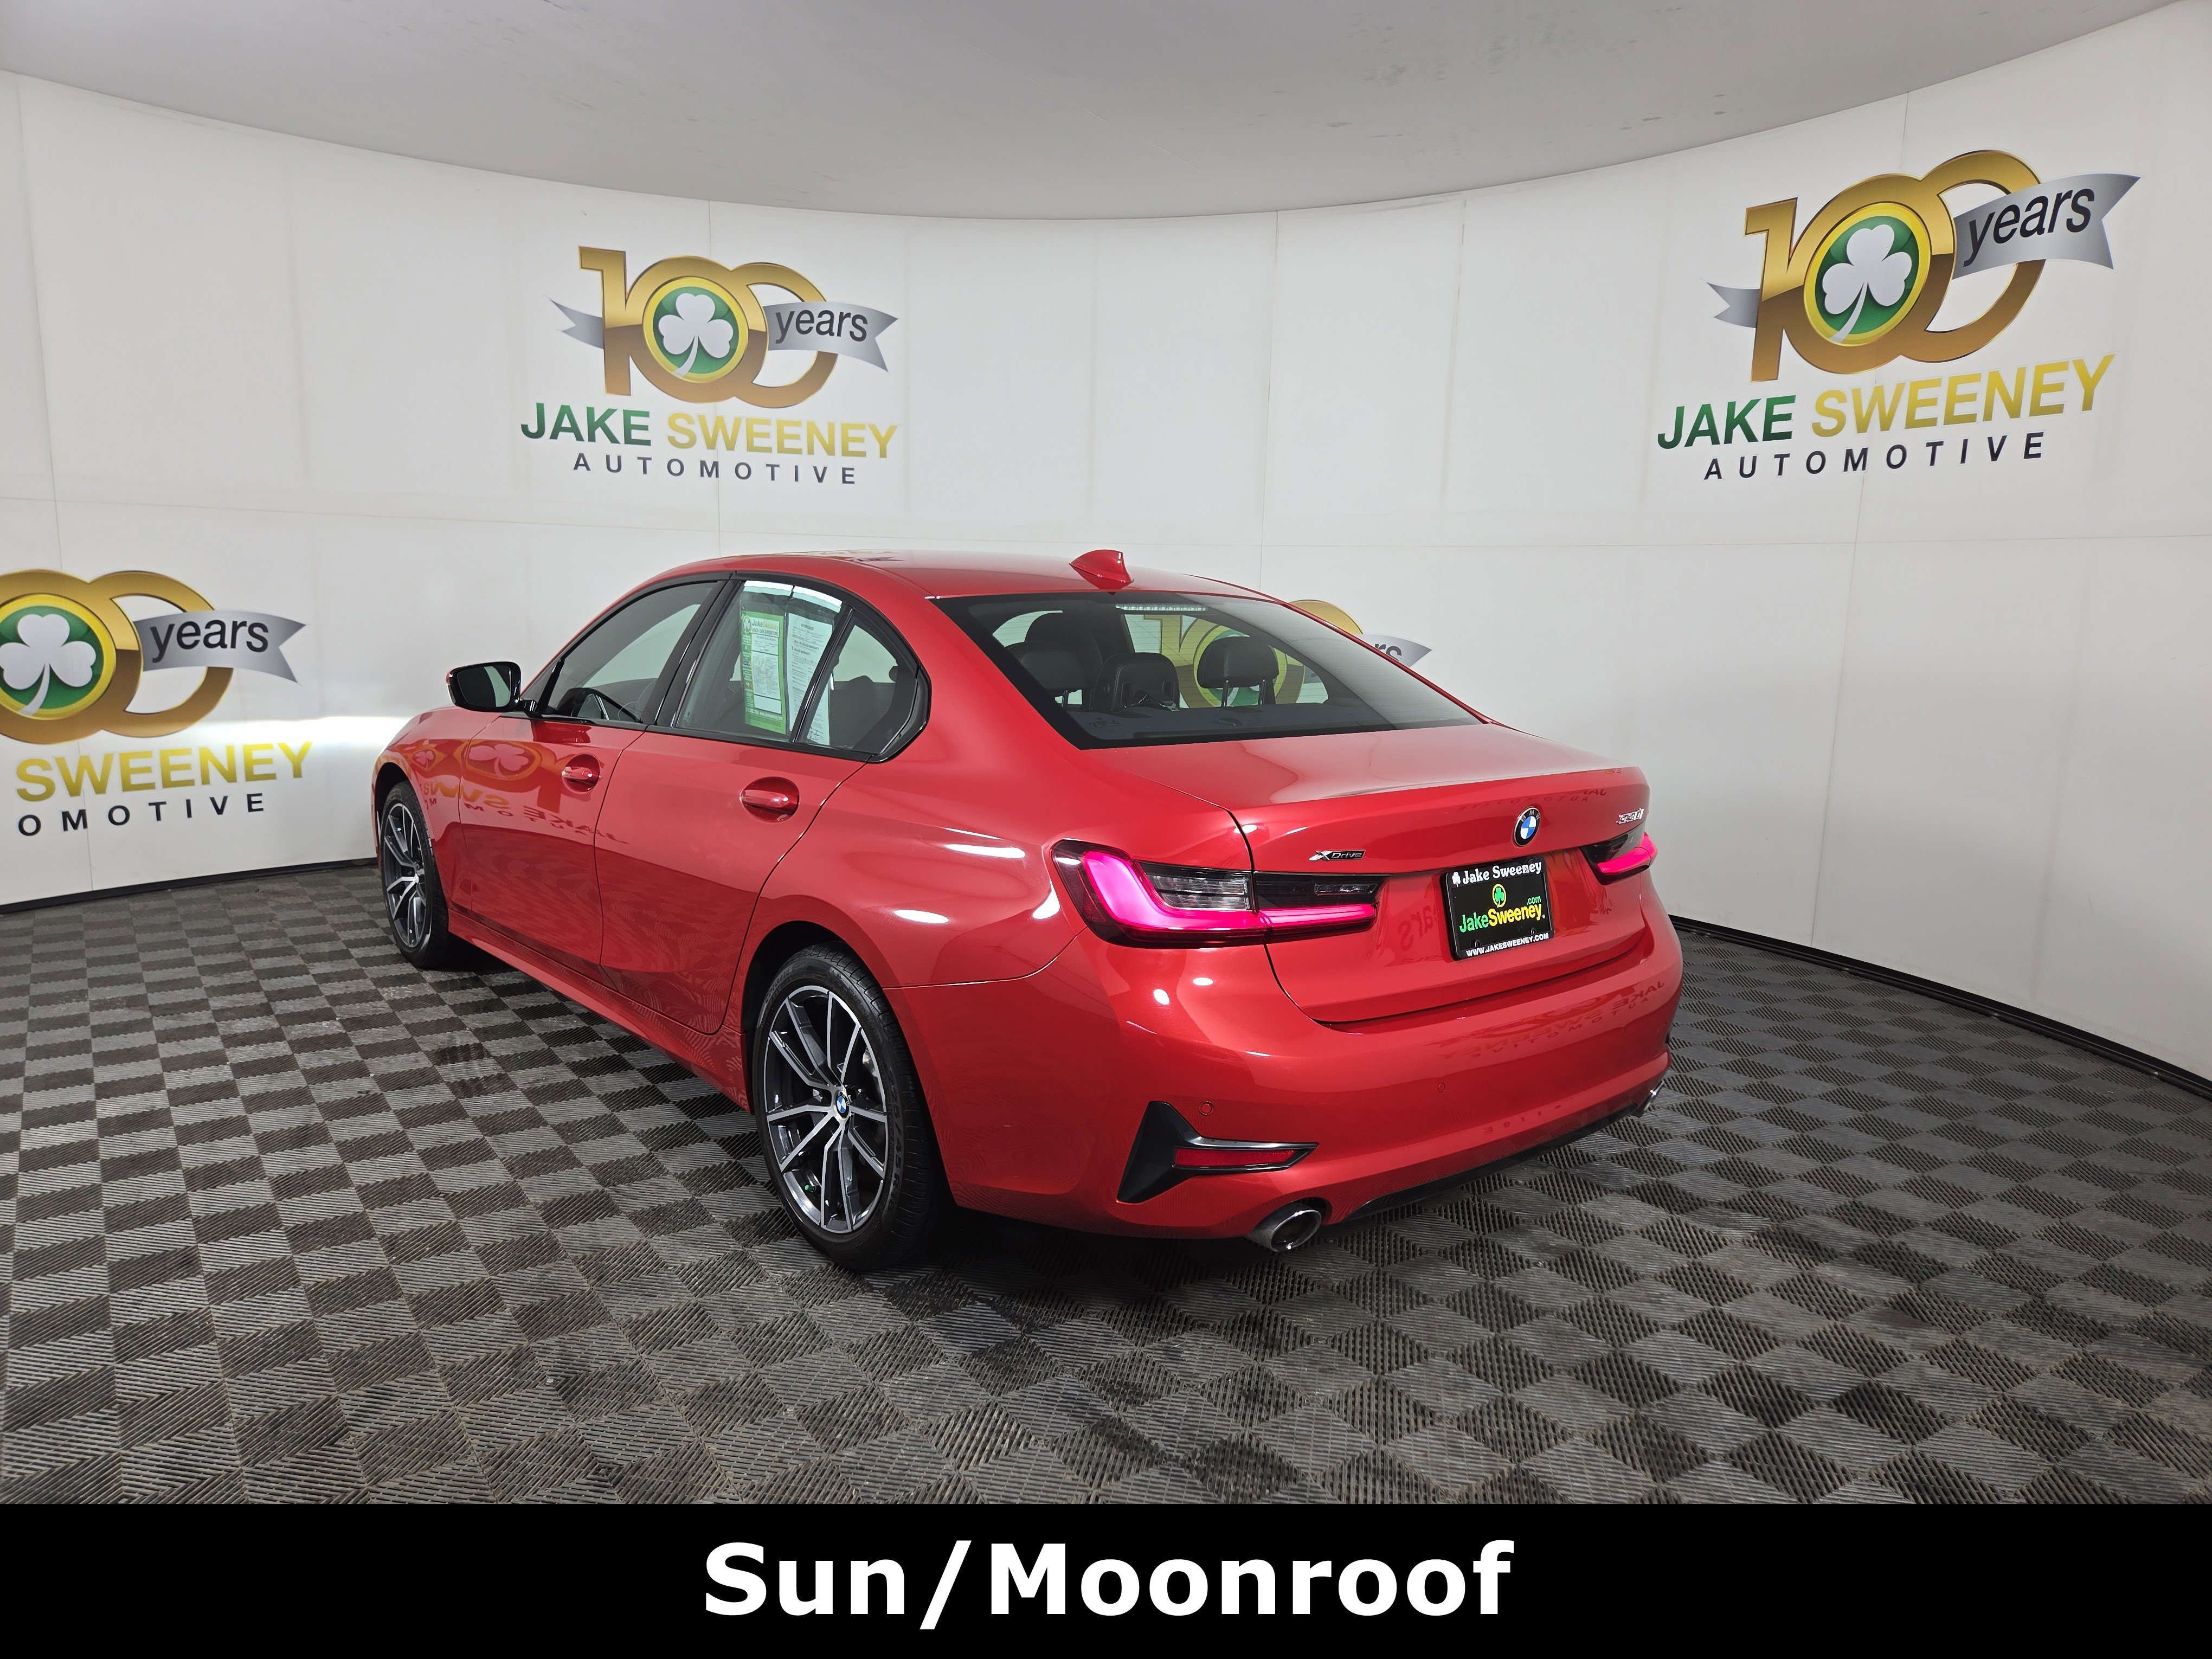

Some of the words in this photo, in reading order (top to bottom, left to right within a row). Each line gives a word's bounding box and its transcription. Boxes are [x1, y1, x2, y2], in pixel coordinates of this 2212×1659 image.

[1745, 149, 2046, 382] 100
[1964, 188, 2095, 266] years
[578, 246, 838, 408] 100
[775, 309, 868, 344] years
[1658, 395, 1796, 449] JAKE
[1812, 354, 2115, 438] SWEENEY
[520, 402, 651, 446] JAKE
[667, 413, 898, 458] SWEENEY
[574, 453, 855, 484] AUTOMOTIVE
[1704, 432, 2044, 480] AUTOMOTIVE
[150, 620, 269, 663] years
[16, 741, 312, 802] SWEENEY
[18, 793, 264, 837] OMOTIVE
[1521, 809, 1540, 822] BMW
[1463, 869, 1489, 884] Jake
[1492, 861, 1542, 879] Sweeney
[1526, 896, 1541, 905] .com
[1466, 932, 1549, 957] WWW.JAKESWEENEY.COM
